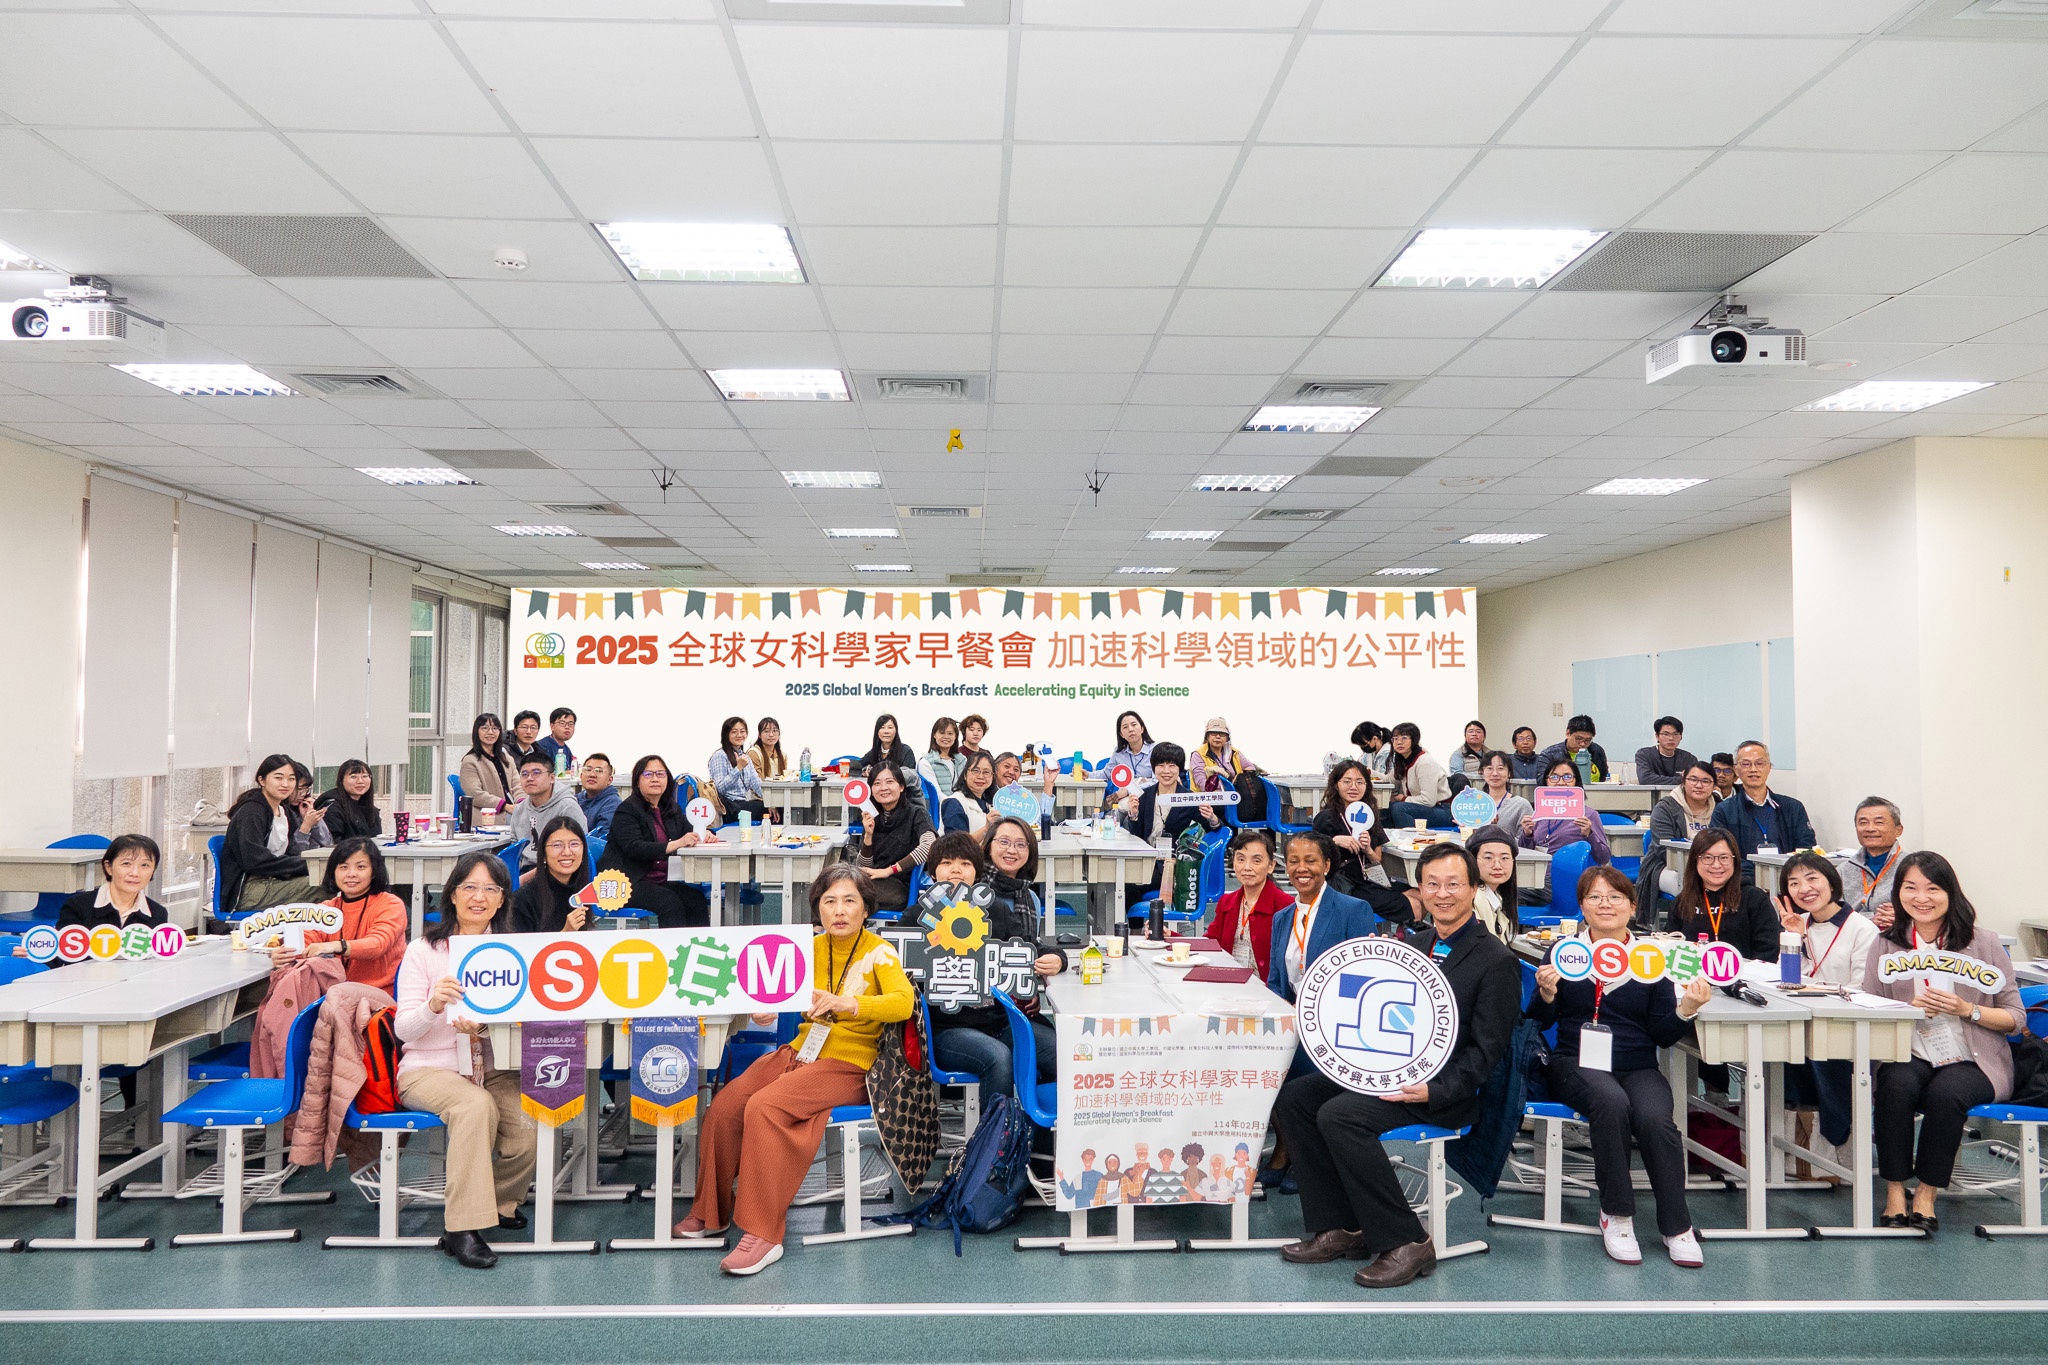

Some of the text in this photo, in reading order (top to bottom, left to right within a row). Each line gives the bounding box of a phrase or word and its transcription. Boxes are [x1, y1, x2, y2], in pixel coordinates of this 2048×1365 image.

[576, 630, 1466, 670] 2025 全球女科學家早餐會 加速科學領域的公平性
[785, 683, 1190, 700] 2025 Global Women's Breakfast Accelerating Equity in Science
[998, 796, 1035, 812] GREAT!
[1170, 795, 1224, 803] 國立中興大學工學院
[1541, 799, 1578, 807] KEEP IT
[691, 805, 709, 818] +1
[1456, 802, 1491, 811] GREAT!
[1552, 807, 1567, 815] UP
[1185, 868, 1197, 911] Roots
[244, 908, 338, 937] AMAZING
[29, 940, 55, 949] NCHU
[1559, 954, 1588, 964] NCHU
[1885, 955, 1999, 986] AMAZING
[464, 969, 521, 988] NCHU
[1305, 944, 1450, 1050] COLLEGE OF ENGINEERING NCHU
[664, 1025, 696, 1033] ENGINEERING
[1314, 1044, 1434, 1089] 國立中興大學工學院
[1073, 1074, 1115, 1090] 2025
[1073, 1091, 1224, 1110] 加速科學領域的公平性
[1073, 1109, 1174, 1120] 2025 Global Women's Breakfast
[1073, 1118, 1111, 1127] Accelerating
[1111, 1116, 1131, 1125] Equity
[1214, 1119, 1269, 1131] 114年02月1
